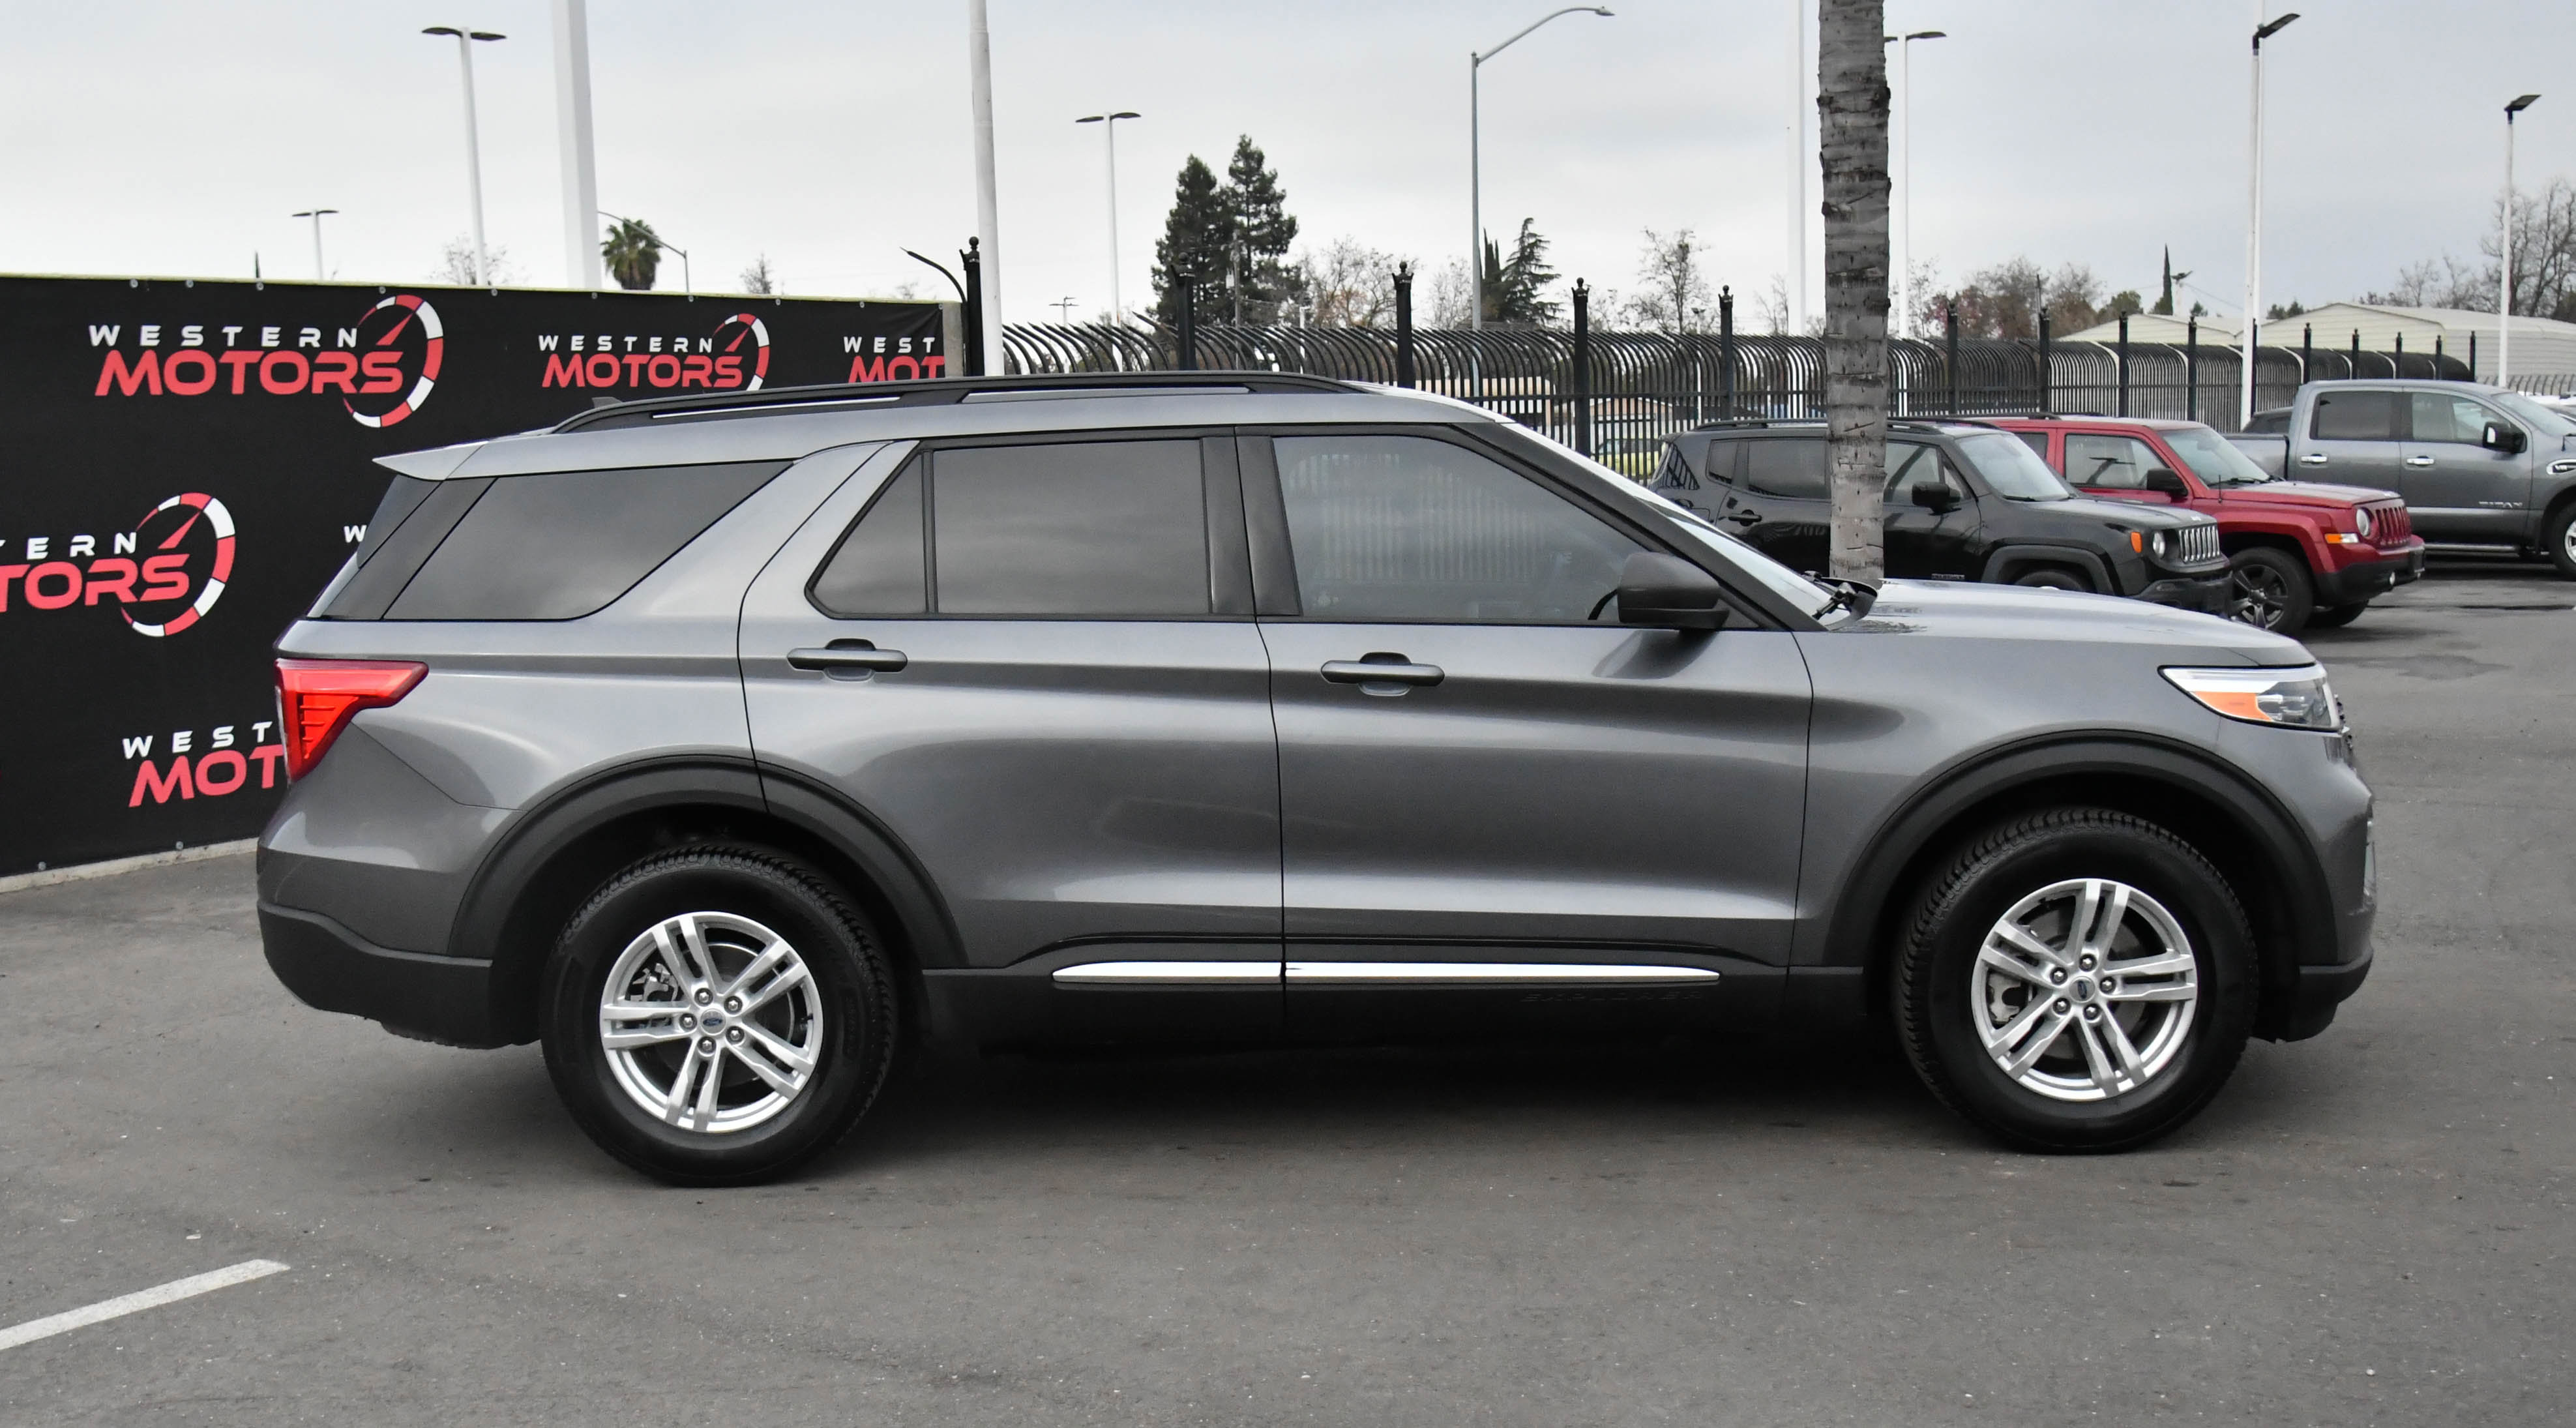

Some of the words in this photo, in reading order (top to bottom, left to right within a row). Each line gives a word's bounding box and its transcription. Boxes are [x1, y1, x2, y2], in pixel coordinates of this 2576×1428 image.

[89, 325, 358, 348] WESTERN
[539, 335, 713, 353] WESTERN
[843, 336, 935, 353] WEST
[95, 350, 404, 396] MOTORS
[542, 353, 743, 388] MOTORS
[848, 355, 945, 383] MOT
[123, 721, 273, 759] WEST
[128, 744, 284, 808] MOT
